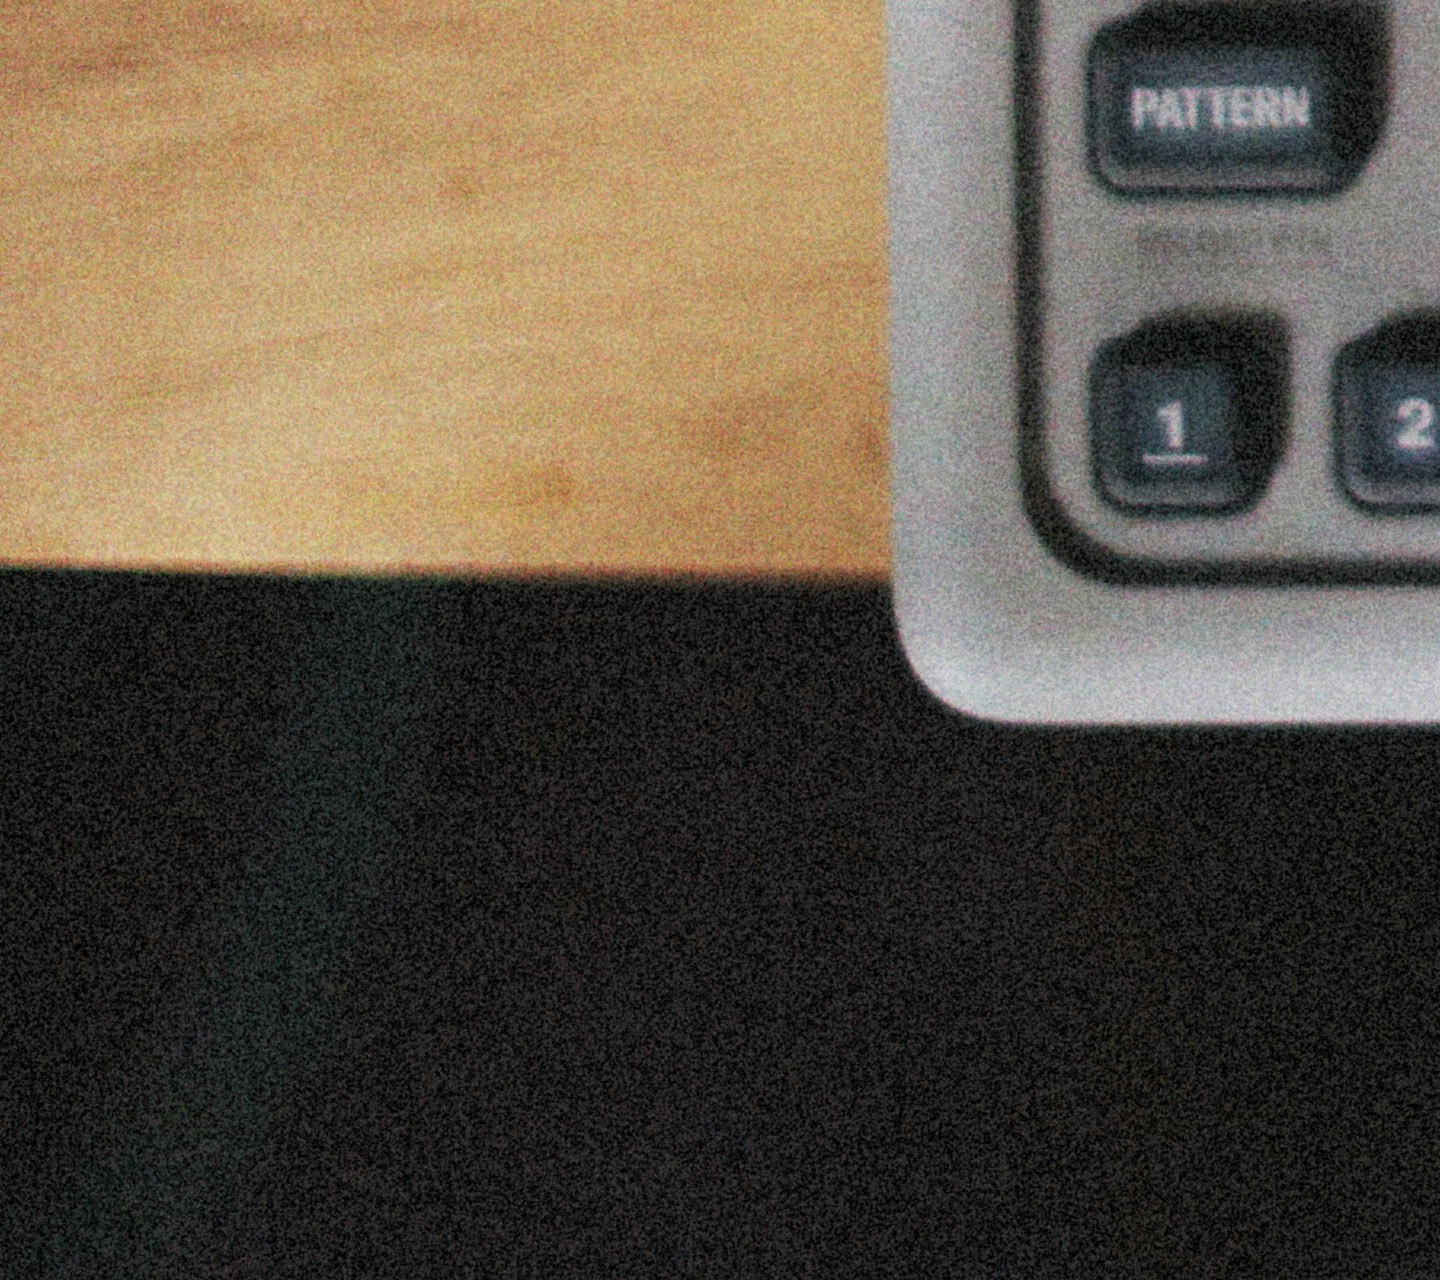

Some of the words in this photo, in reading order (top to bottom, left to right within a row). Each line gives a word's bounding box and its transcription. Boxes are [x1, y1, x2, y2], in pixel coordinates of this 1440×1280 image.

[1131, 85, 1310, 132] PATTERN
[1157, 401, 1184, 450] 1
[1395, 398, 1436, 451] 2
